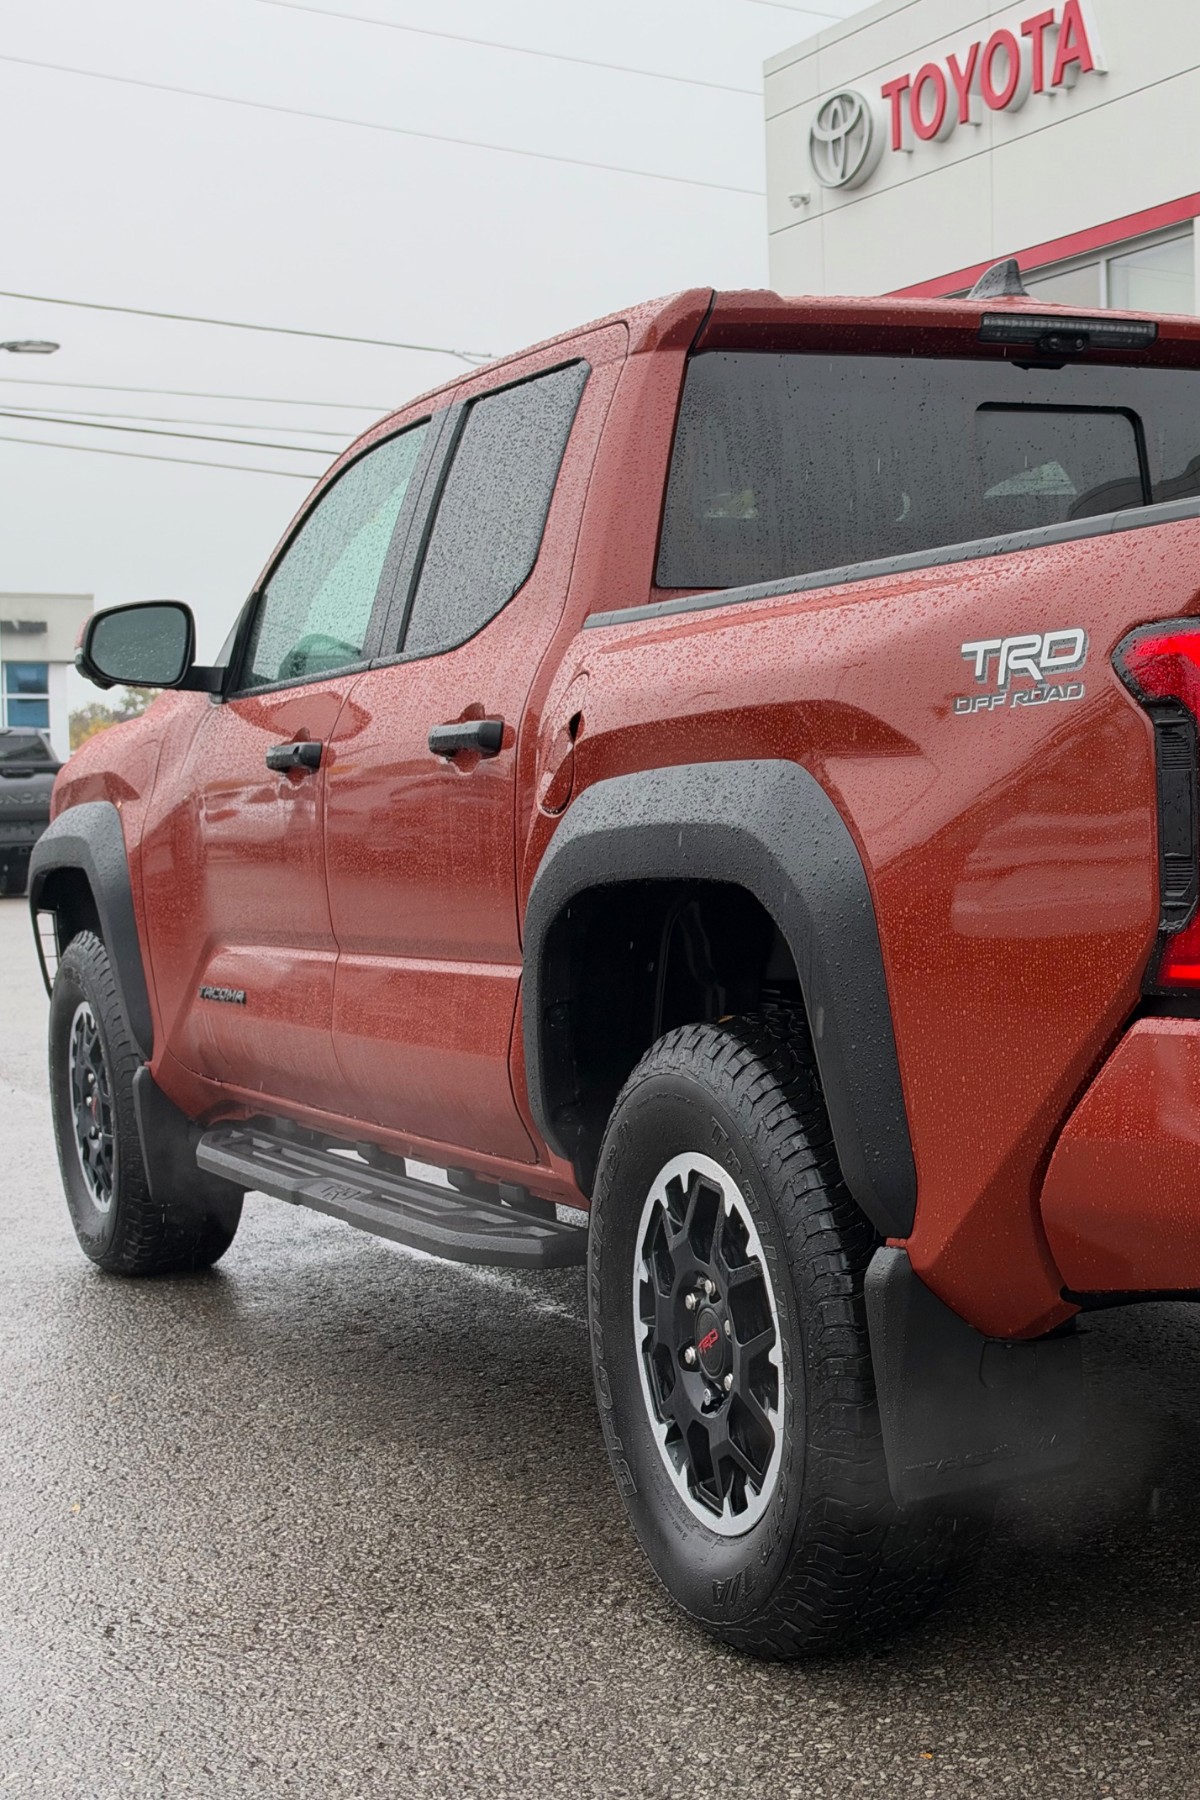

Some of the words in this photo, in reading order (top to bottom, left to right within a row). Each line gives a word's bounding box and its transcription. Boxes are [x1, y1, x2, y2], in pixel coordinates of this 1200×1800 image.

[881, 0, 1096, 152] TOYOTA
[961, 628, 1088, 690] TRD
[953, 692, 1007, 715] OFF
[1010, 683, 1085, 709] ROAD
